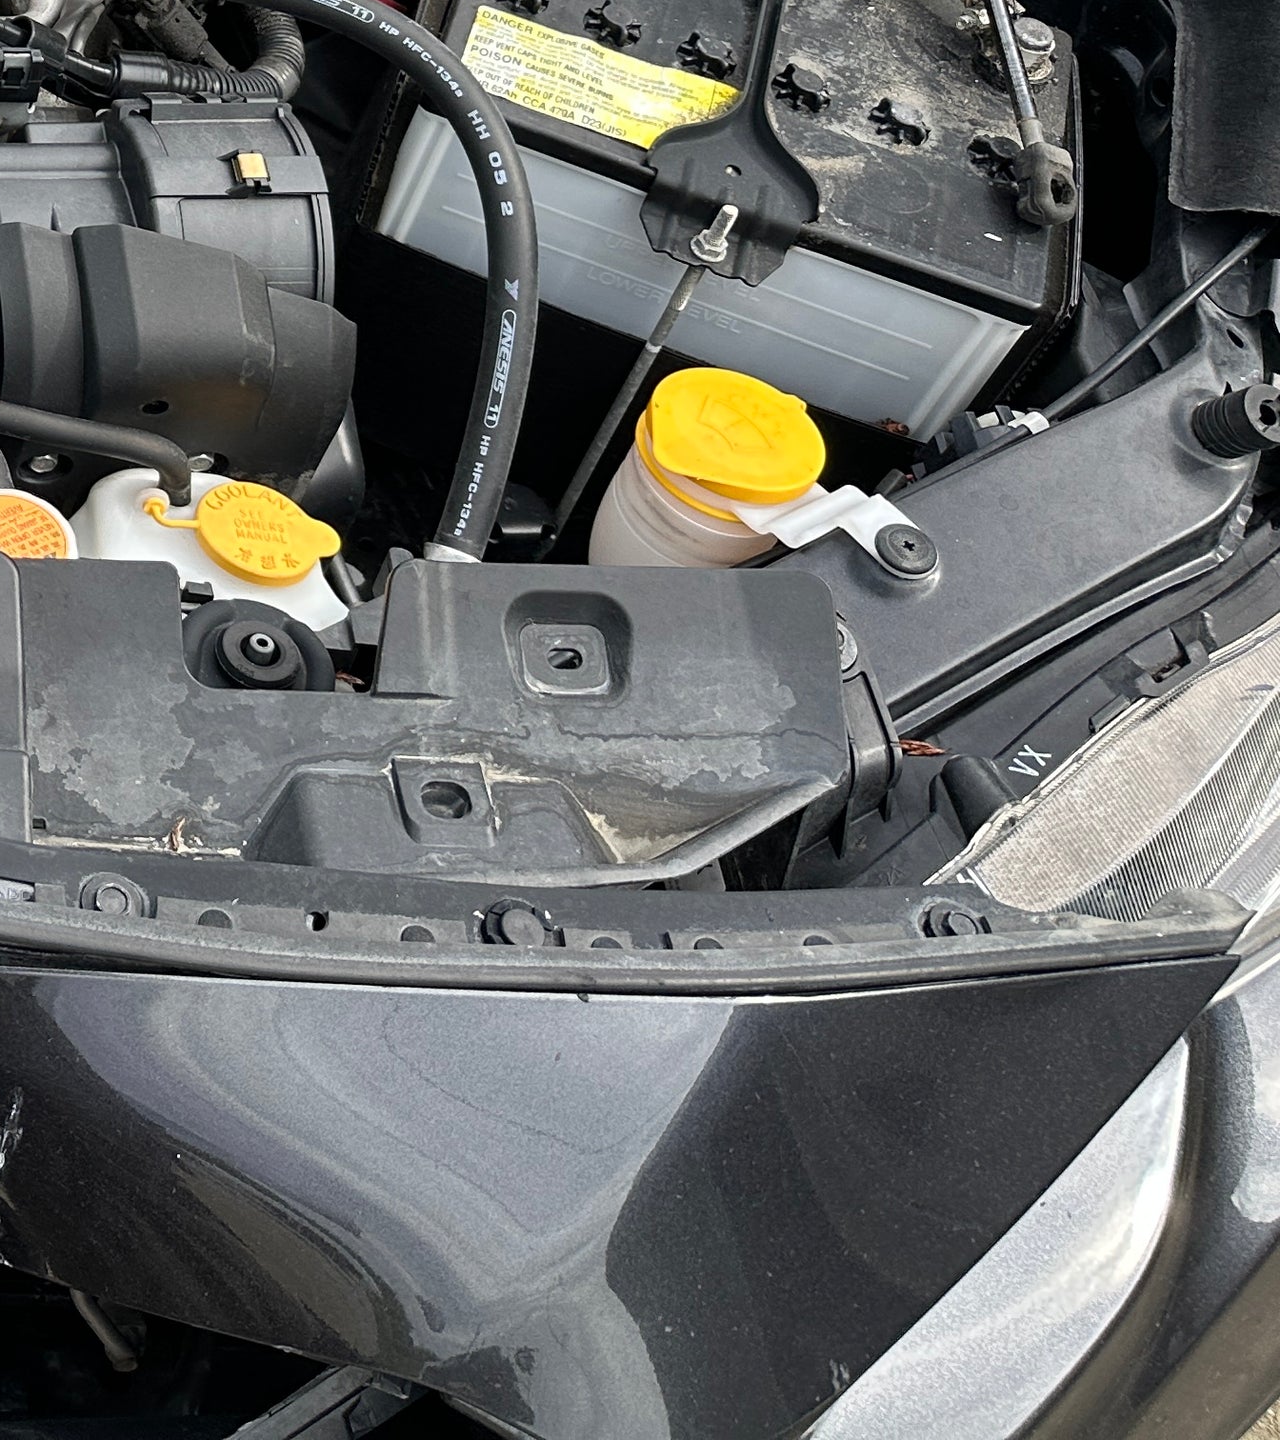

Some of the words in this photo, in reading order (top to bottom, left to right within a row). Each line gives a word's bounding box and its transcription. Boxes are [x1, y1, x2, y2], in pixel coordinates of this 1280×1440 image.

[379, 21, 400, 36] HP
[481, 10, 534, 35] DANGER
[537, 28, 578, 50] EXPLOSIVE
[580, 43, 606, 59] GASES
[402, 37, 464, 98] HFC-134a
[470, 42, 522, 69] POISON
[525, 61, 556, 78] CAUSES
[558, 73, 585, 89] SEVERE
[587, 86, 614, 101] BURNS
[474, 33, 494, 47] KEEP
[495, 41, 515, 54] VENT
[517, 47, 538, 61] CAPS
[539, 55, 562, 69] TIGHT
[563, 64, 580, 76] AND
[581, 71, 605, 86] LEVEL
[485, 71, 501, 82] OUT
[502, 77, 513, 87] OF
[514, 81, 541, 97] REACH
[542, 91, 553, 101] OF
[554, 94, 595, 116] CHILDREN
[467, 109, 491, 140] HH
[491, 83, 518, 100] 62Ah
[522, 95, 548, 111] CCA
[581, 115, 628, 139] D23(JIS)
[488, 151, 508, 185] 05
[500, 201, 514, 216] 2
[586, 266, 665, 303] LOWER
[686, 303, 741, 334] EVEL
[479, 434, 491, 456] HP
[205, 484, 303, 517] COOLANT
[239, 508, 263, 520] SEE
[454, 462, 484, 536] HFC-134a
[234, 517, 284, 533] OWNERS
[235, 528, 288, 544] MANUAL
